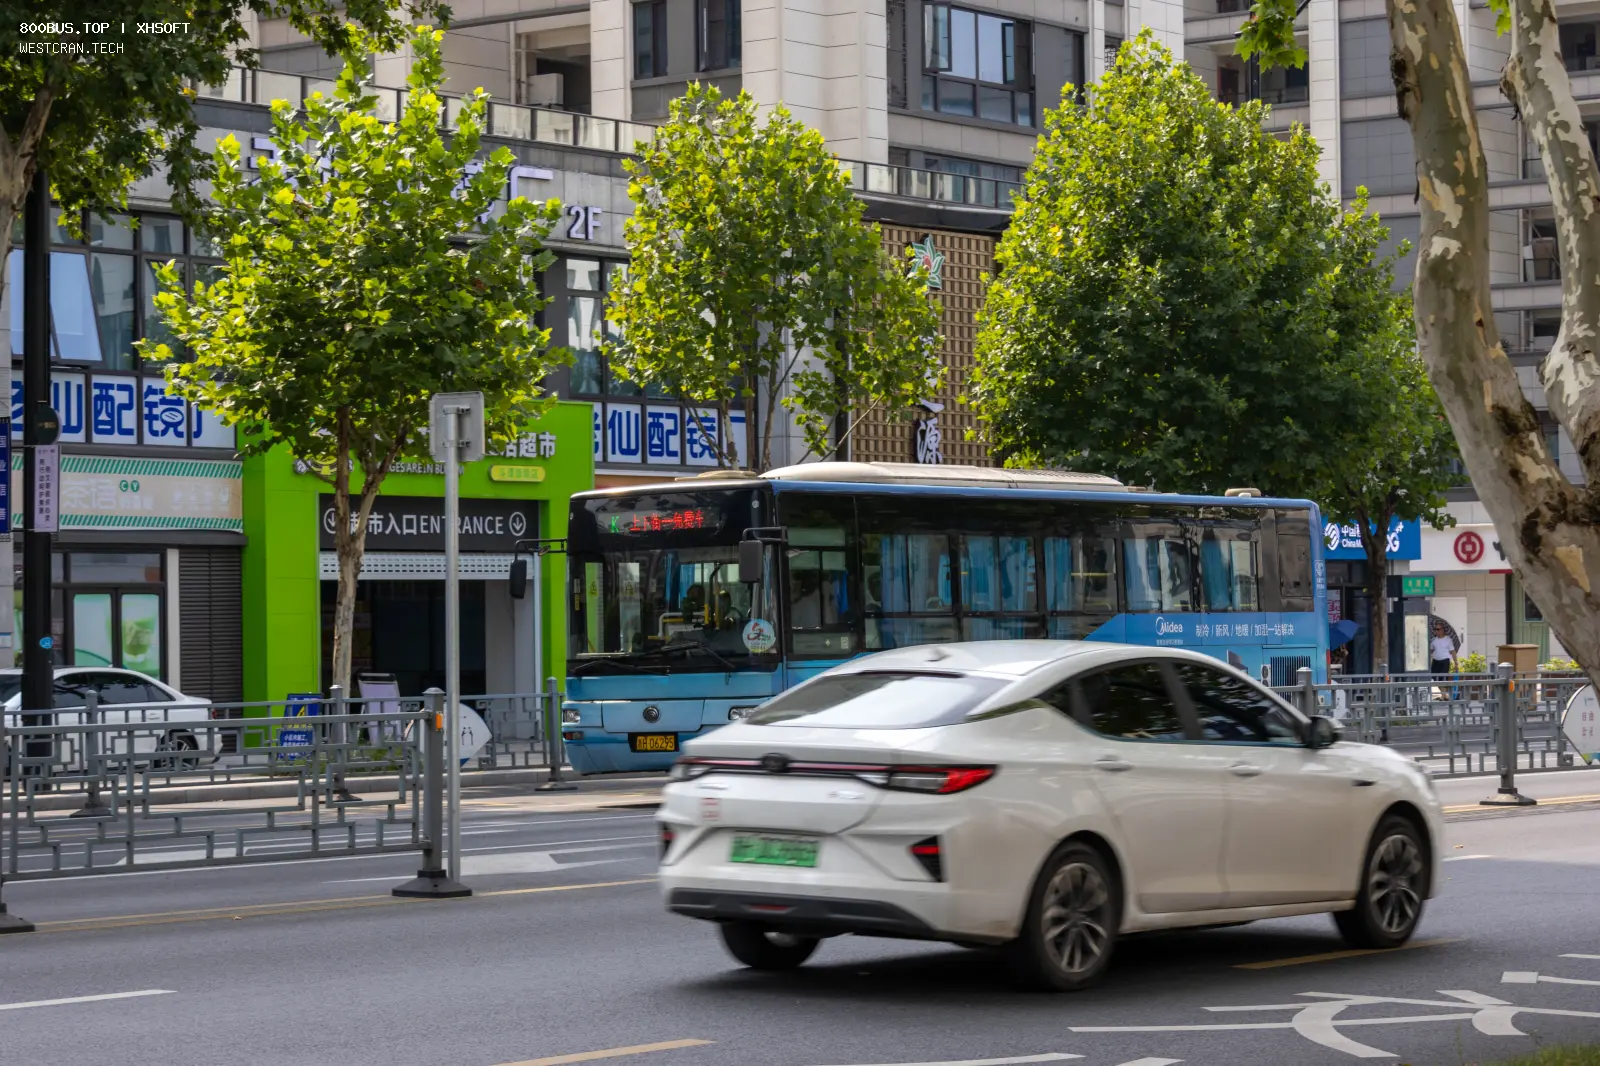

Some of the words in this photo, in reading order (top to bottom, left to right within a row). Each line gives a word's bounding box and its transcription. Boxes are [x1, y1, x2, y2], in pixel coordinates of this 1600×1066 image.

[567, 205, 602, 240] 2F
[12, 379, 203, 439] 仙配镜
[594, 409, 746, 460] 仙配镜
[406, 463, 423, 474] ARE
[435, 464, 465, 475] BLM
[611, 515, 620, 533] K
[1156, 616, 1184, 635] Midea
[1195, 624, 1210, 637] 制冷
[1215, 624, 1230, 637] 新风
